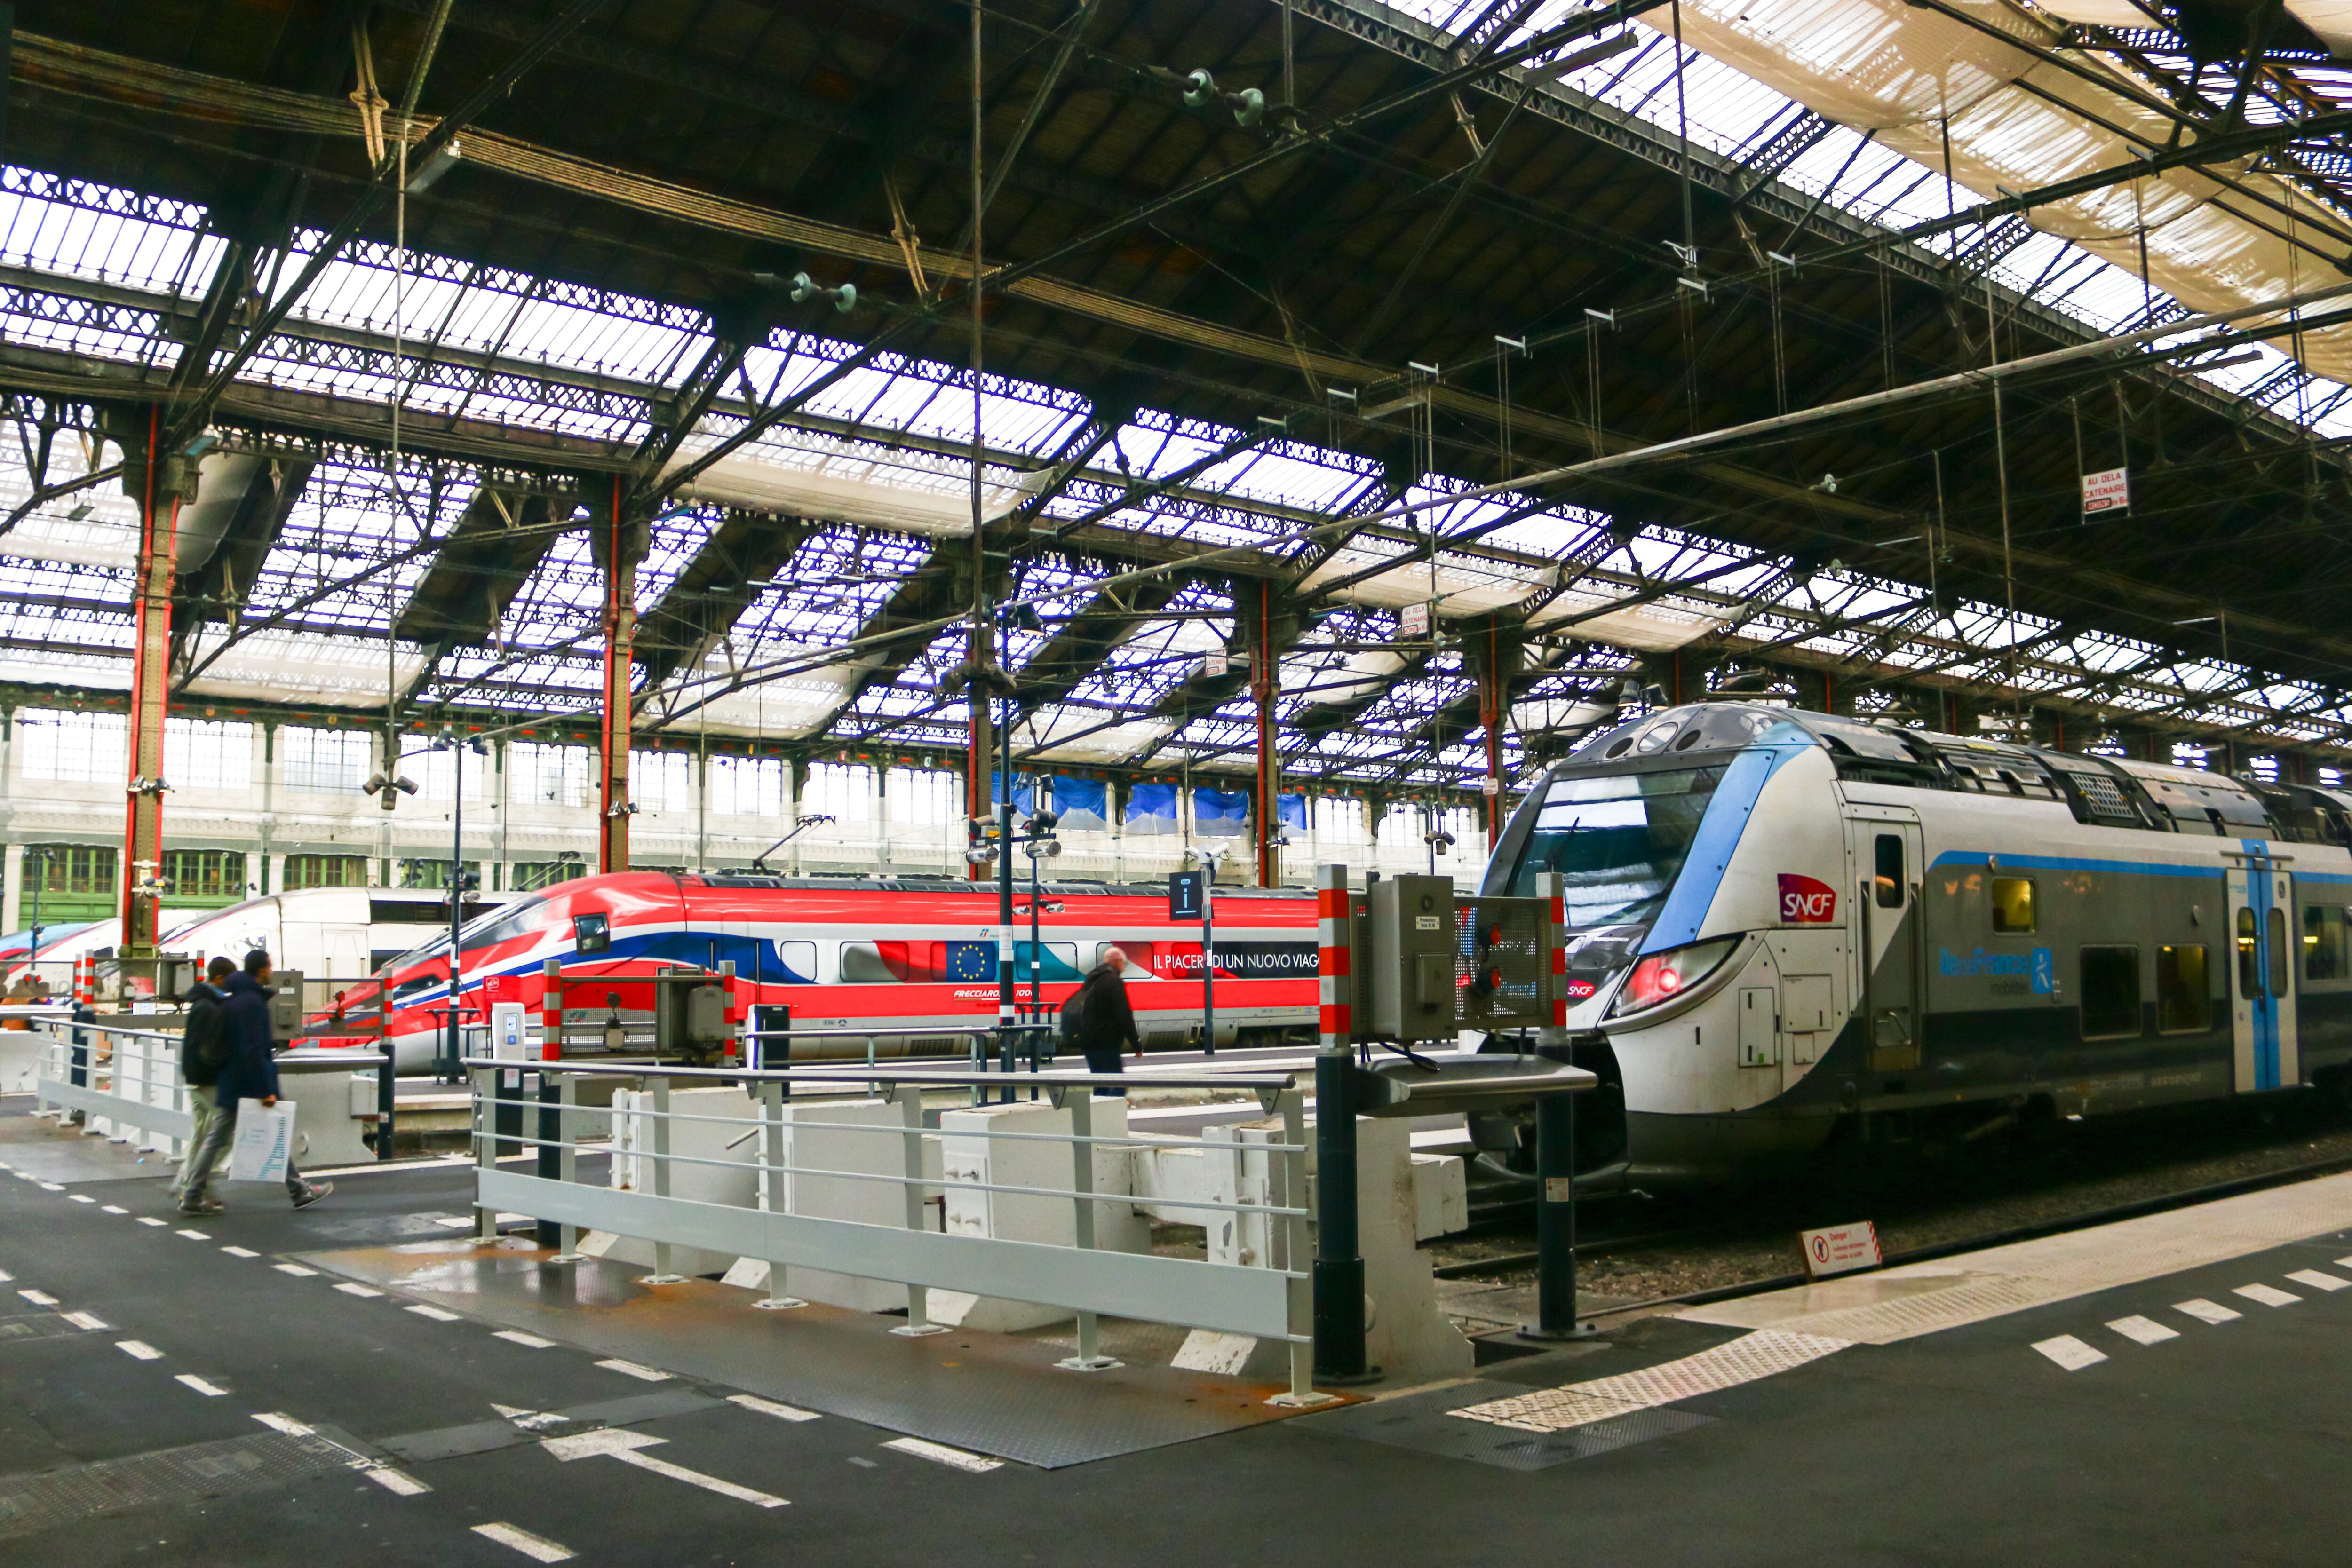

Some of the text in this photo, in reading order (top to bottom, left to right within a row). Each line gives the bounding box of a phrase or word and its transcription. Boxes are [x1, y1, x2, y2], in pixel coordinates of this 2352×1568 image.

[2101, 473, 2121, 483] DELA
[2084, 484, 2126, 498] CATENAIRE
[2088, 499, 2110, 510] MOINS
[1403, 615, 1427, 625] CATENAIRE
[1783, 893, 1832, 916] SNCF
[1154, 954, 1319, 969] IL PIACER DI UN NUOVO VIAG
[1567, 986, 1593, 995] SNCF
